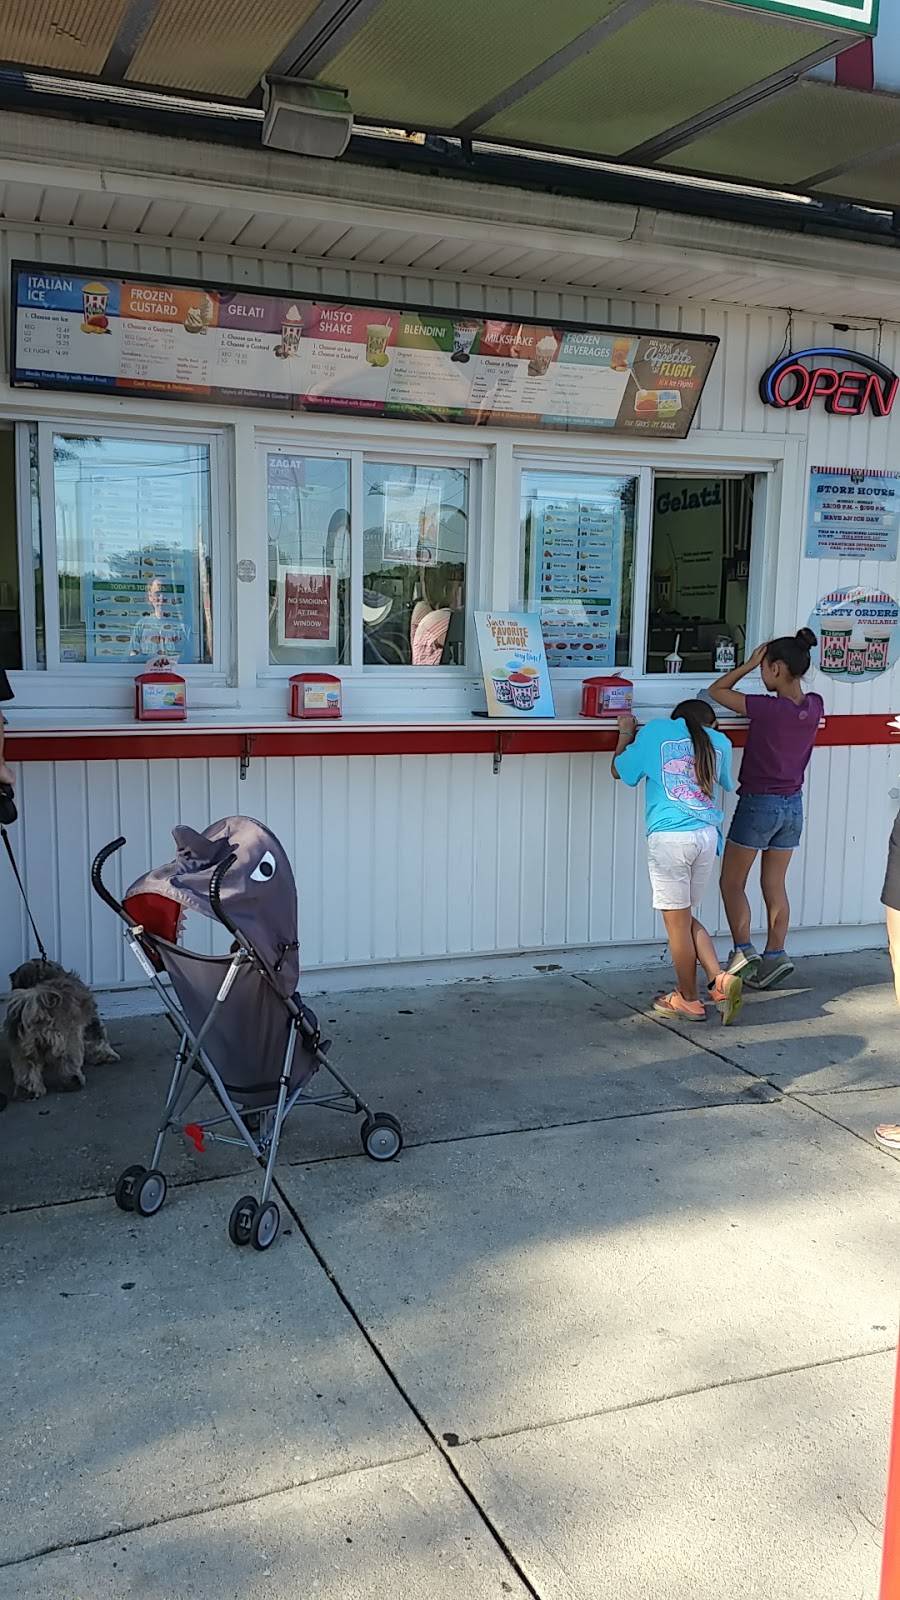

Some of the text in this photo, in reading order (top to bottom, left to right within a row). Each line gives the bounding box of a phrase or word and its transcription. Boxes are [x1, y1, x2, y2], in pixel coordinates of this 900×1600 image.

[28, 276, 73, 292] ITALIAN
[28, 290, 45, 302] ICE
[130, 288, 174, 303] FROZEN
[130, 301, 177, 316] CUSTARD
[228, 304, 265, 319] GELATI
[320, 310, 353, 323] MISTO
[319, 322, 353, 335] SHAKE
[404, 324, 447, 338] BLENDINI
[484, 333, 534, 347] MILKSHAKE
[566, 333, 600, 345] FROZEN
[563, 345, 610, 358] BEVERAGES
[644, 347, 692, 364] Appetite
[660, 363, 697, 378] FLIGHT
[774, 364, 900, 416] OPEN
[270, 459, 303, 468] ZAGAT
[816, 485, 895, 496] STORE HOURS
[656, 484, 722, 515] Gelati
[855, 609, 898, 617] ORDERS
[492, 627, 529, 638] FAVORITE
[496, 636, 527, 647] FLAVOR
